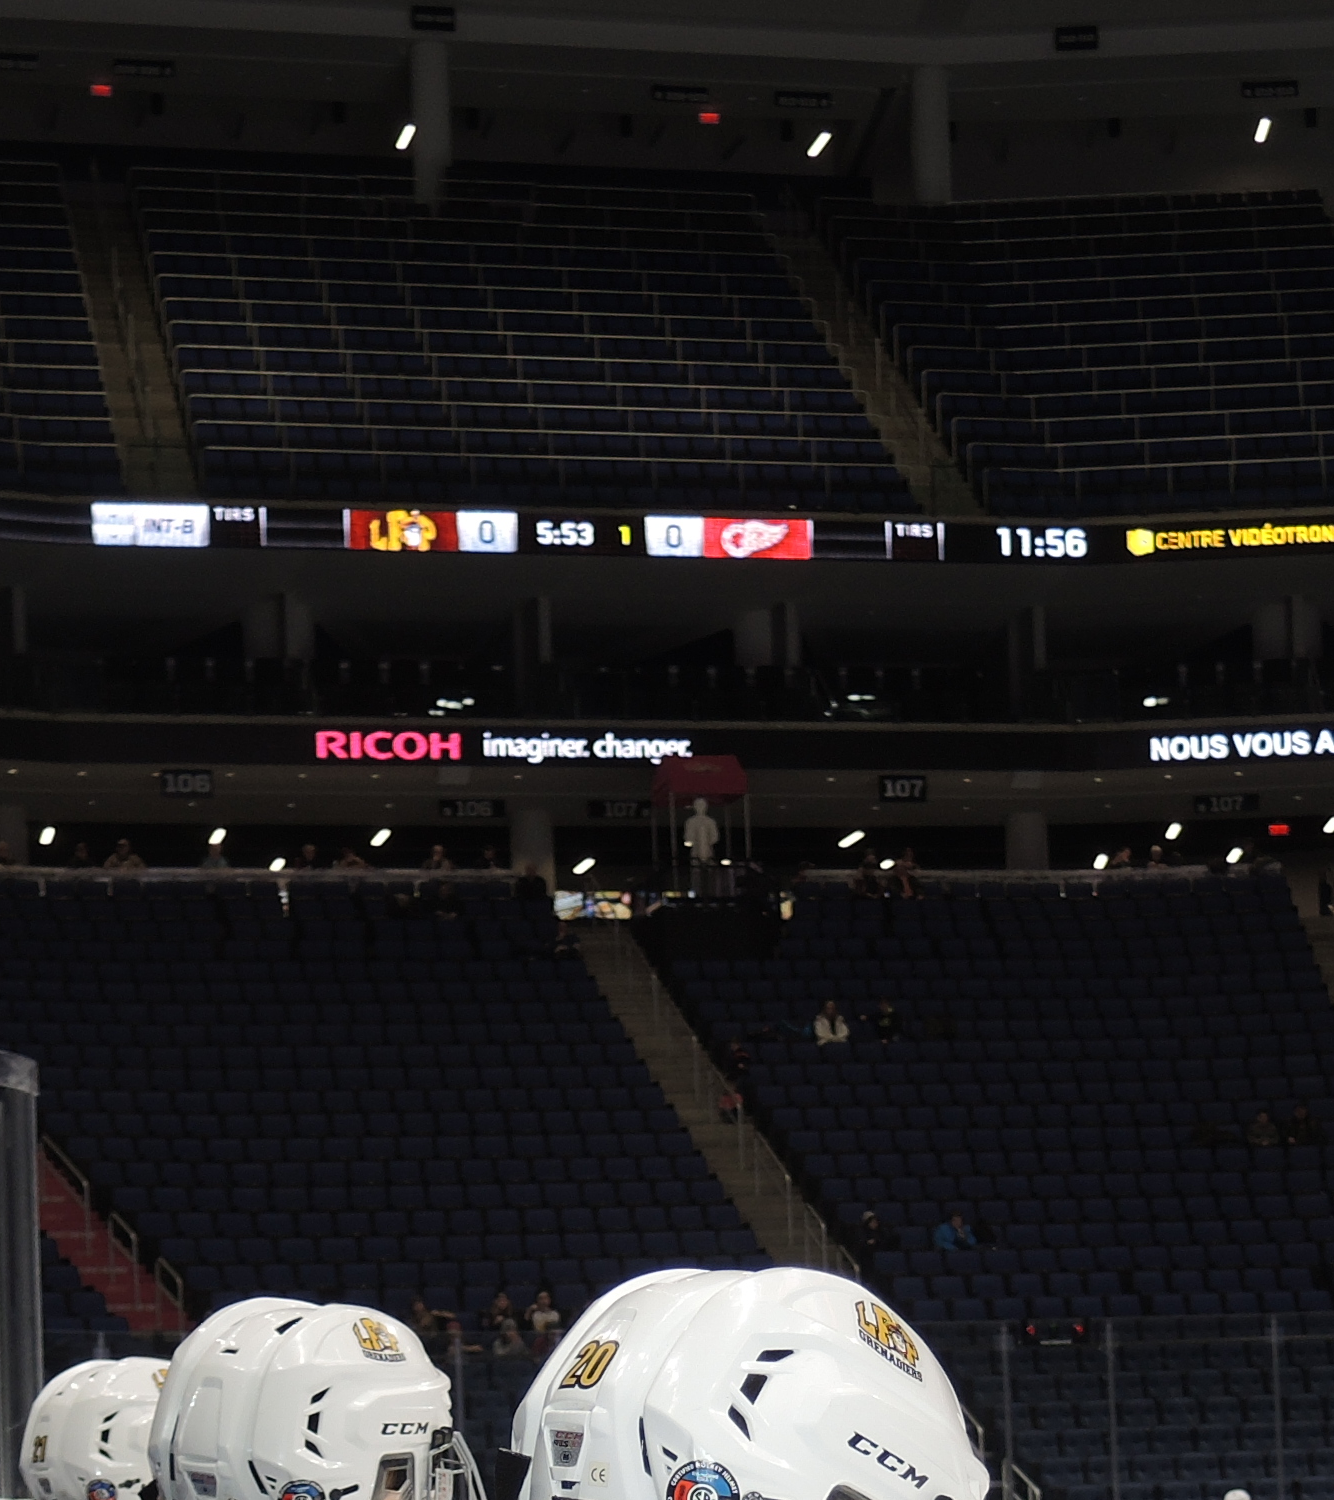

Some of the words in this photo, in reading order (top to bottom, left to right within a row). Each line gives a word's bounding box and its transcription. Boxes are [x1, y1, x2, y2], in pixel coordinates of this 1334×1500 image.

[479, 519, 495, 543] 0
[536, 522, 594, 546] 5:53
[618, 525, 631, 545] 1
[665, 525, 682, 547] 0
[995, 527, 1087, 558] 11:56
[1156, 529, 1225, 549] CENTRE
[316, 730, 461, 761] RICOH
[483, 731, 589, 763] imaginer.
[593, 732, 692, 764] changer.
[1150, 734, 1229, 761] NOUS
[1232, 730, 1312, 757] VOUS
[883, 778, 923, 801] 107
[558, 1339, 618, 1390] 20
[381, 1422, 430, 1435] CCM
[847, 1431, 931, 1490] CCM
[591, 1468, 606, 1483] CE
